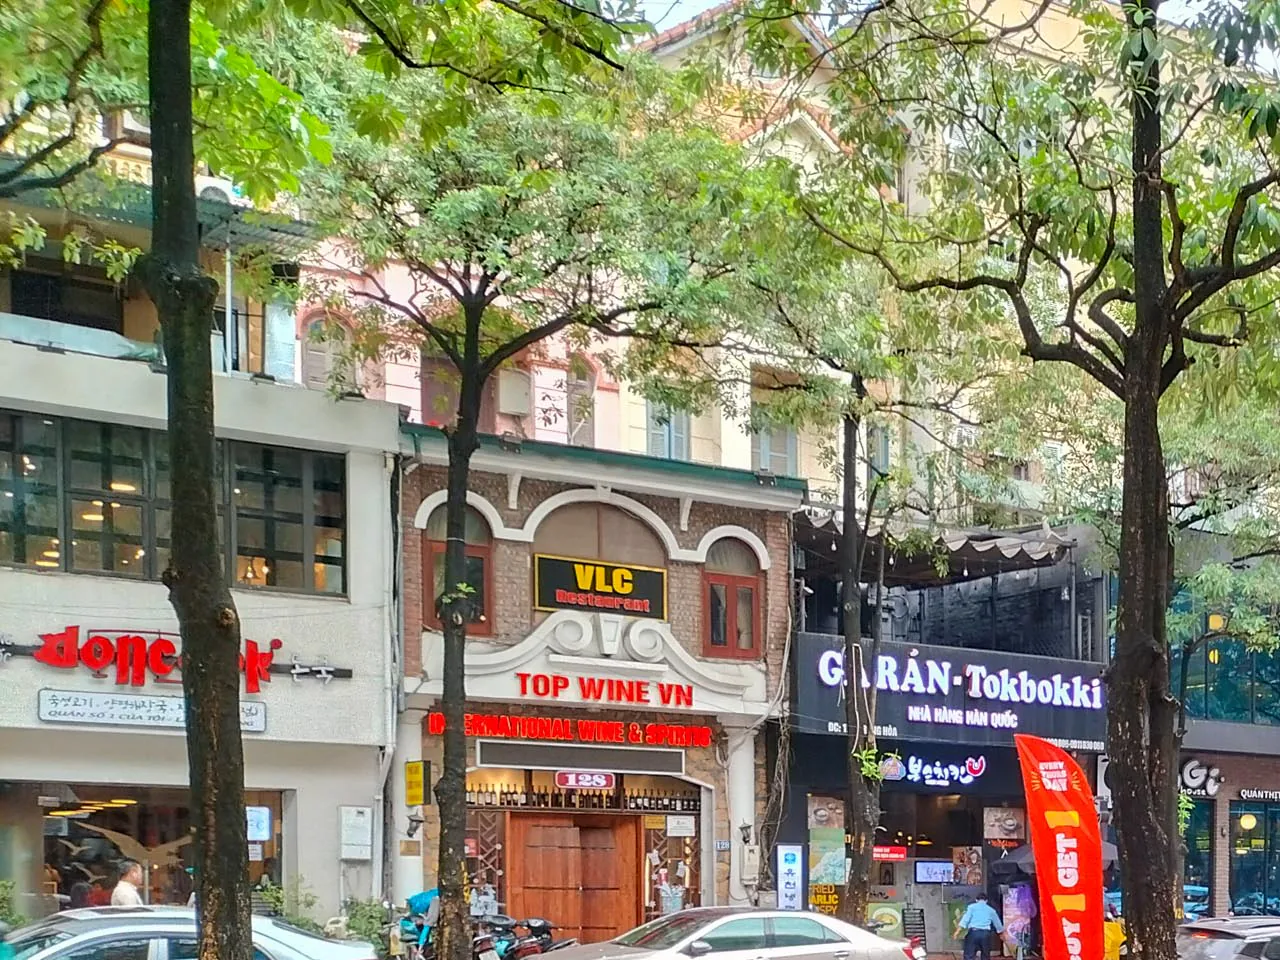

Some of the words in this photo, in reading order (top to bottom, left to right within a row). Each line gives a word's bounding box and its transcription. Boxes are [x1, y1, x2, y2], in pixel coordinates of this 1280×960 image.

[573, 563, 633, 595] VLC
[555, 589, 650, 613] Restaurant
[33, 625, 273, 693] donck
[516, 672, 569, 698] TOP
[578, 676, 650, 704] WINE
[657, 682, 693, 707] VN
[965, 664, 1102, 708] Tokbokki
[908, 704, 932, 722] NHÀ
[934, 706, 963, 724] HÀNG
[965, 708, 988, 727] HÀN
[991, 708, 1018, 729] QUỐC
[429, 712, 573, 740] INERNATIONAL
[578, 719, 625, 743] WINE
[628, 722, 643, 743] &
[646, 723, 712, 748] SPIRITS
[564, 773, 607, 787] 128
[1042, 778, 1068, 791] DAY
[1180, 788, 1206, 796] house
[1241, 788, 1264, 798] QUÁN
[1044, 810, 1080, 829] 1
[716, 841, 730, 850] 128
[1055, 833, 1080, 888] GET
[1051, 893, 1086, 912] 1
